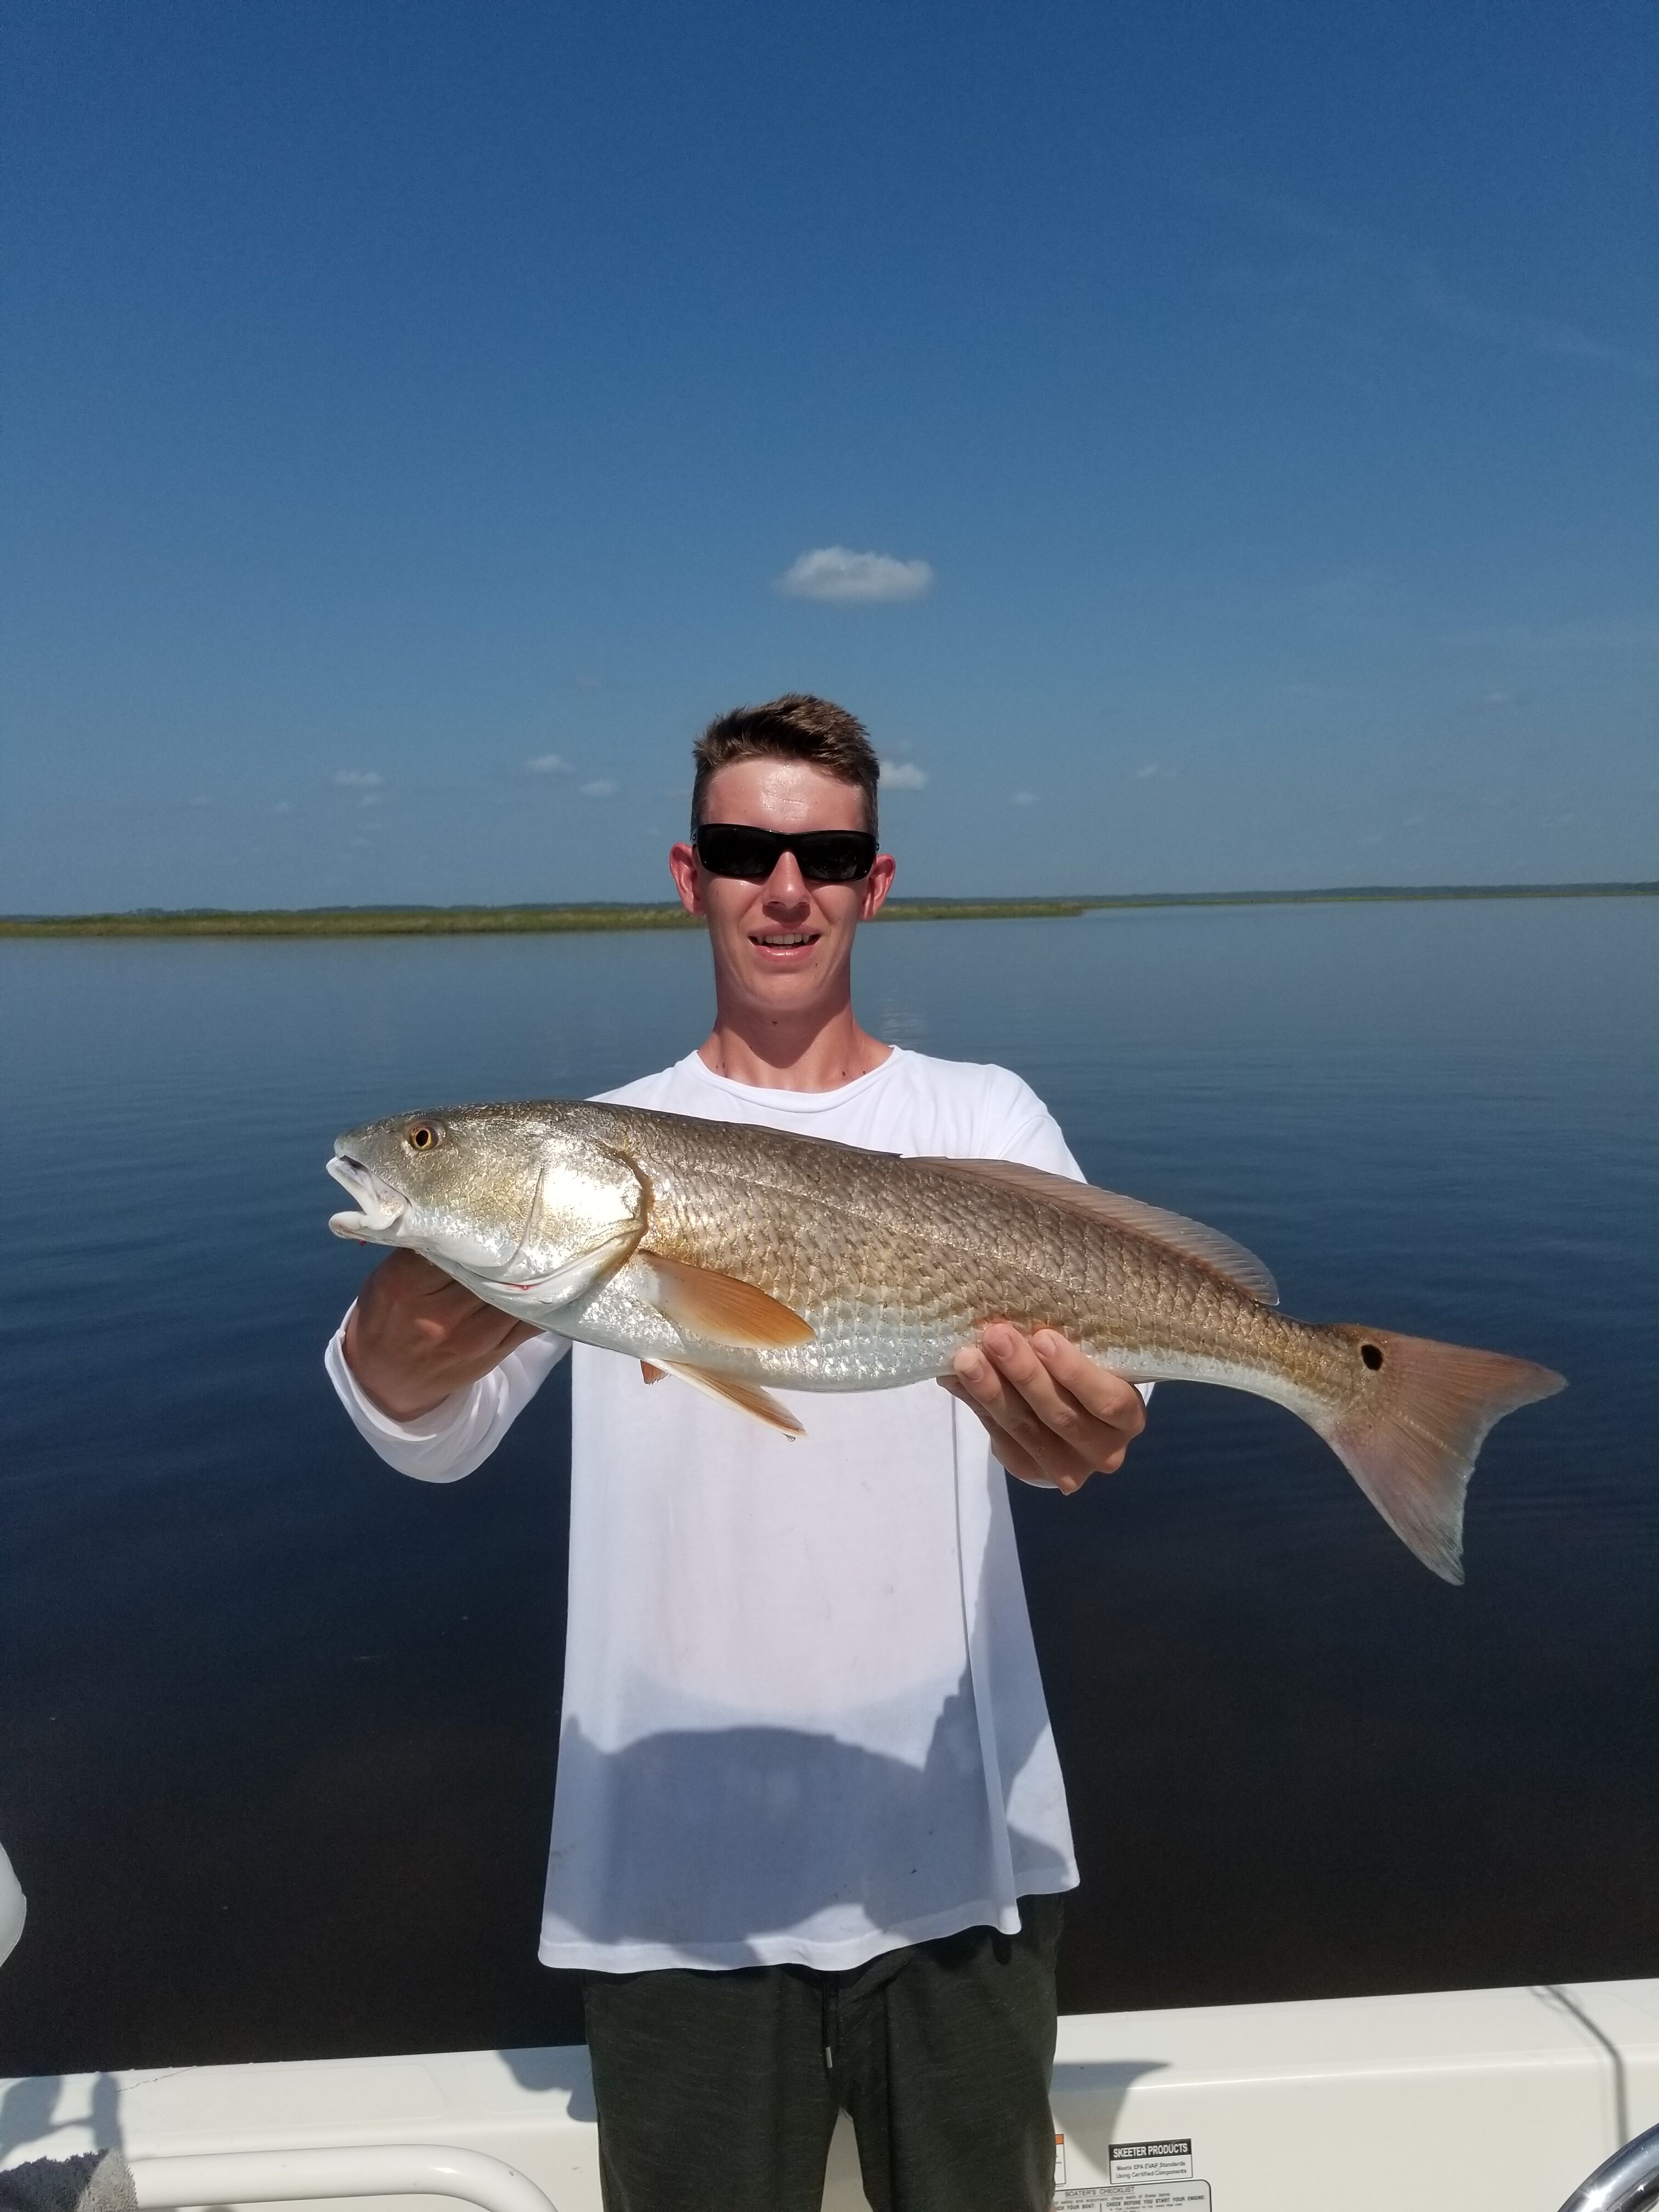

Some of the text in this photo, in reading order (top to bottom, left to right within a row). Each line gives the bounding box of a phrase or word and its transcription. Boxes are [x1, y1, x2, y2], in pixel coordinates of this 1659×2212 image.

[1113, 2143, 1188, 2158] SKEETER PRODUCTS
[1099, 2186, 1135, 2194] CHECKLIST
